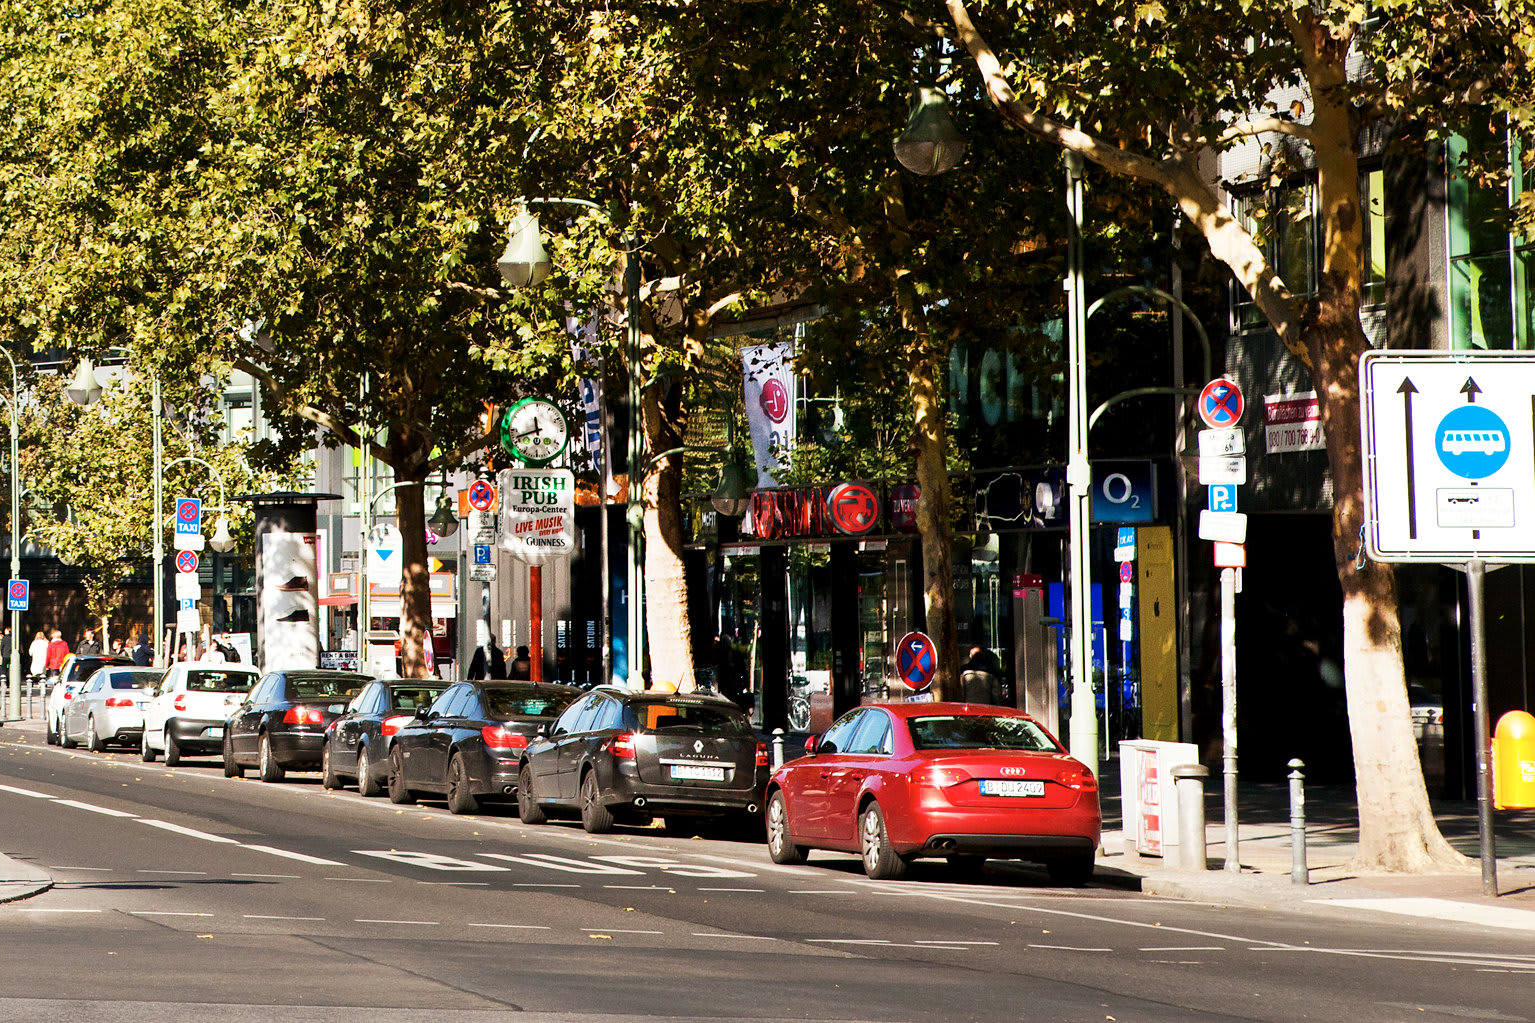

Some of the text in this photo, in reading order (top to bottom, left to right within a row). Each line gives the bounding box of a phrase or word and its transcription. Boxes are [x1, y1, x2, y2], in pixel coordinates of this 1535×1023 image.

[513, 476, 567, 490] IRISH
[521, 490, 558, 505] PUB
[512, 505, 568, 514] Europa-Center
[178, 522, 198, 533] TAXI
[515, 516, 563, 534] LIVE MUSIK
[525, 536, 566, 547] GUINNESS
[557, 621, 566, 648] SATURN
[586, 621, 595, 648] SATURN
[350, 850, 758, 877] BUS
